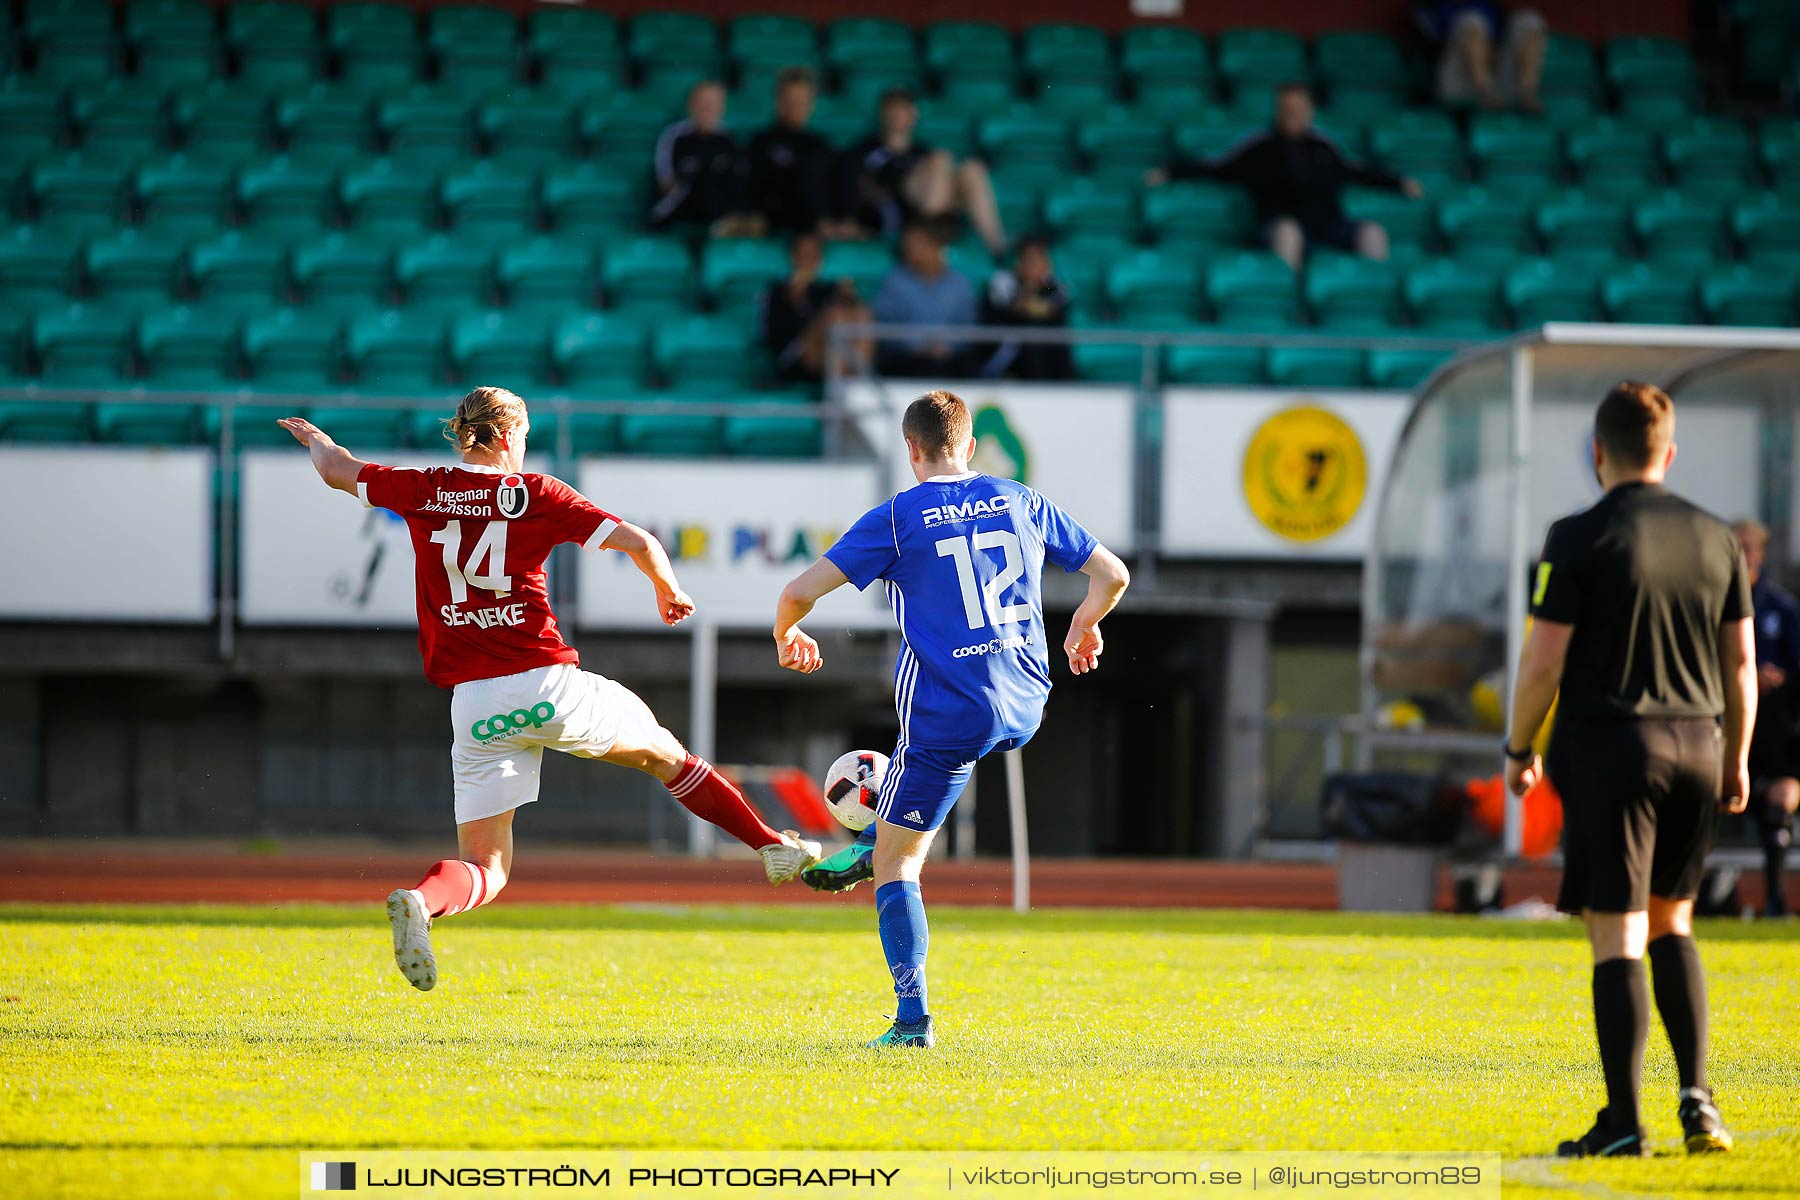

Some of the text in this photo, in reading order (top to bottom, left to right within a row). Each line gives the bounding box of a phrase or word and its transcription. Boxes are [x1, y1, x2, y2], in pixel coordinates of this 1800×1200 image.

[417, 499, 492, 516] johansson
[437, 487, 491, 506] ingemar
[926, 516, 976, 529] PROFESSIONAL
[430, 519, 512, 604] 14
[935, 529, 1031, 631] 12
[441, 603, 526, 629] SENEKE
[471, 701, 555, 741] coop
[481, 728, 523, 746] ALINGSÅS
